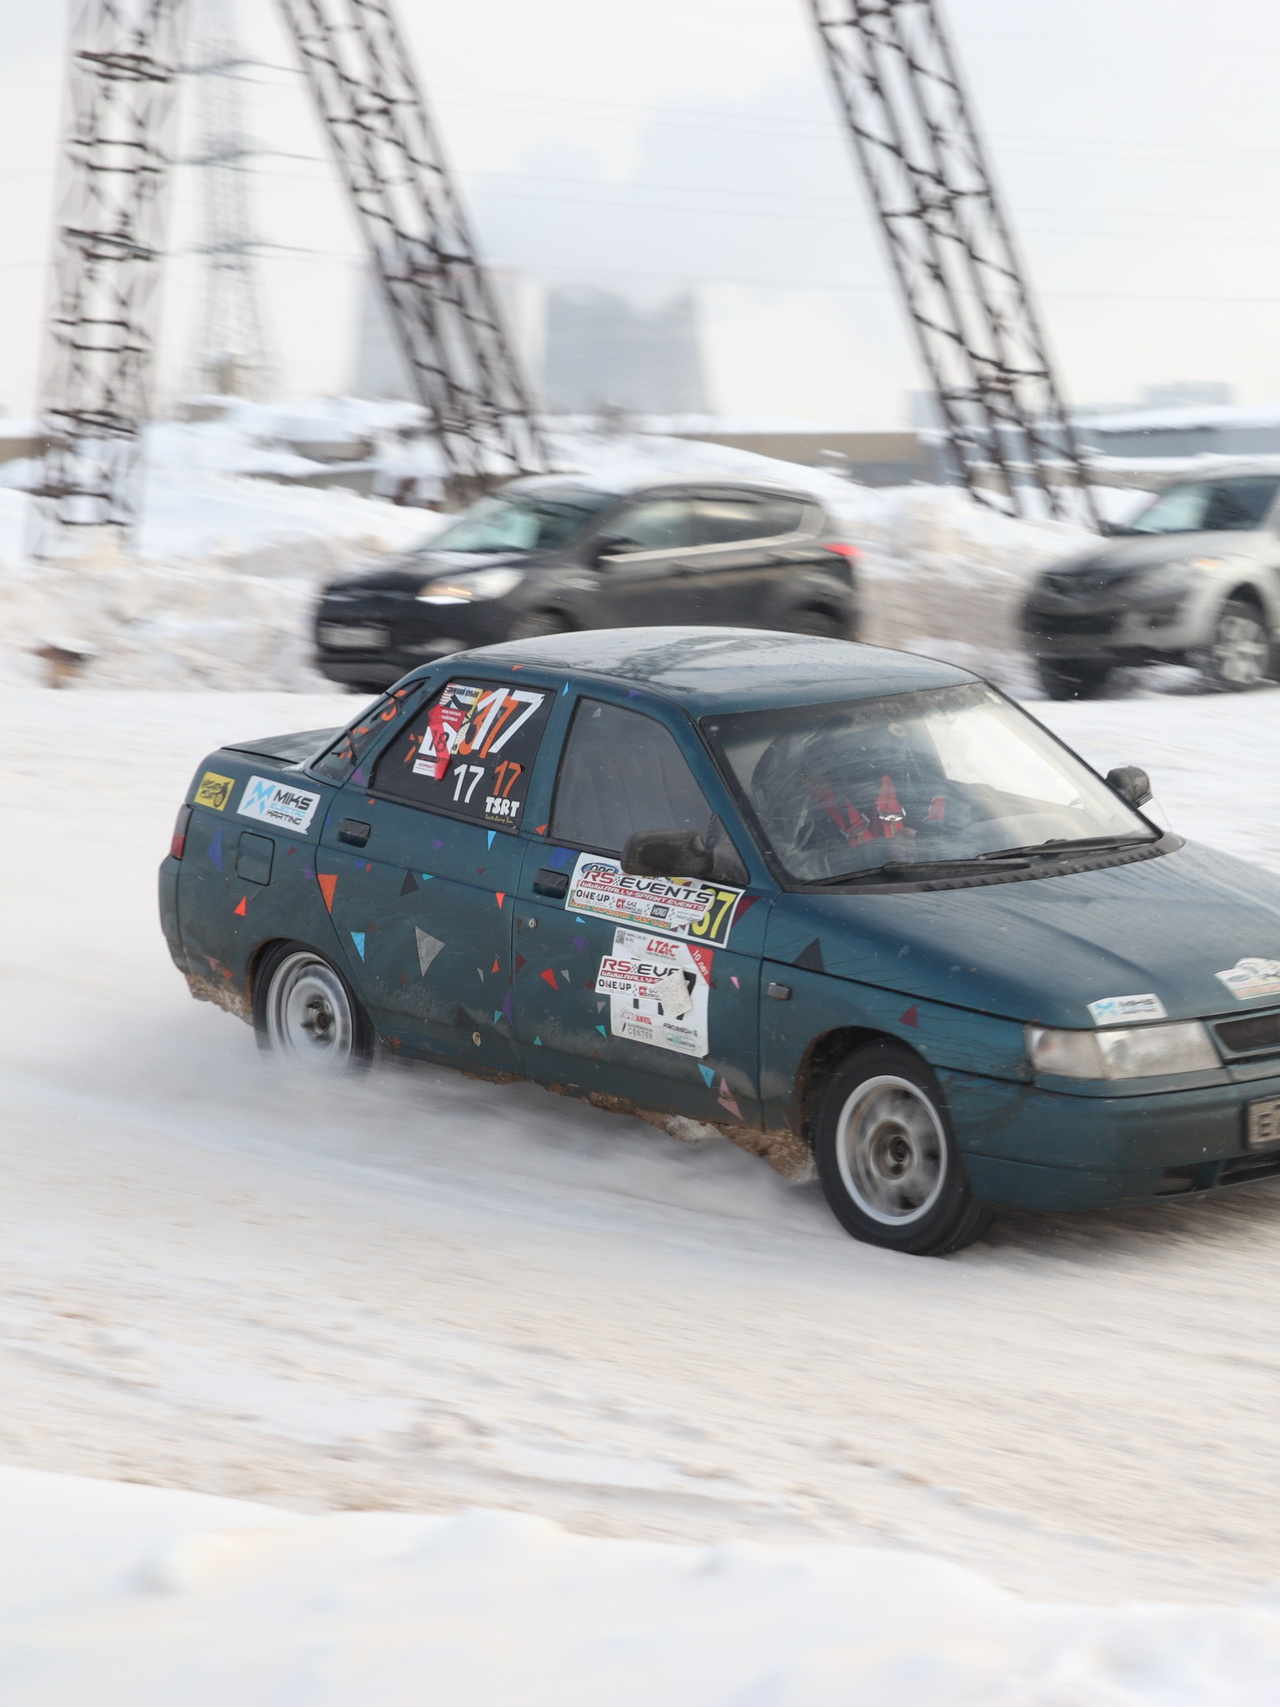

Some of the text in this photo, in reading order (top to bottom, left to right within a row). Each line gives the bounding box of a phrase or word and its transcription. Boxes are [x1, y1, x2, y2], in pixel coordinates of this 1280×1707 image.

[471, 688, 545, 753] 17
[454, 764, 485, 803] 17
[493, 761, 522, 798] 17
[269, 802, 306, 818] ELECTRO
[273, 789, 314, 811] MIKS
[485, 796, 520, 818] TSRT
[266, 809, 303, 825] KARTING
[619, 877, 715, 904] EVENTS
[646, 939, 680, 957] LTAC
[692, 949, 702, 961] 10
[628, 1028, 653, 1040] CENTER
